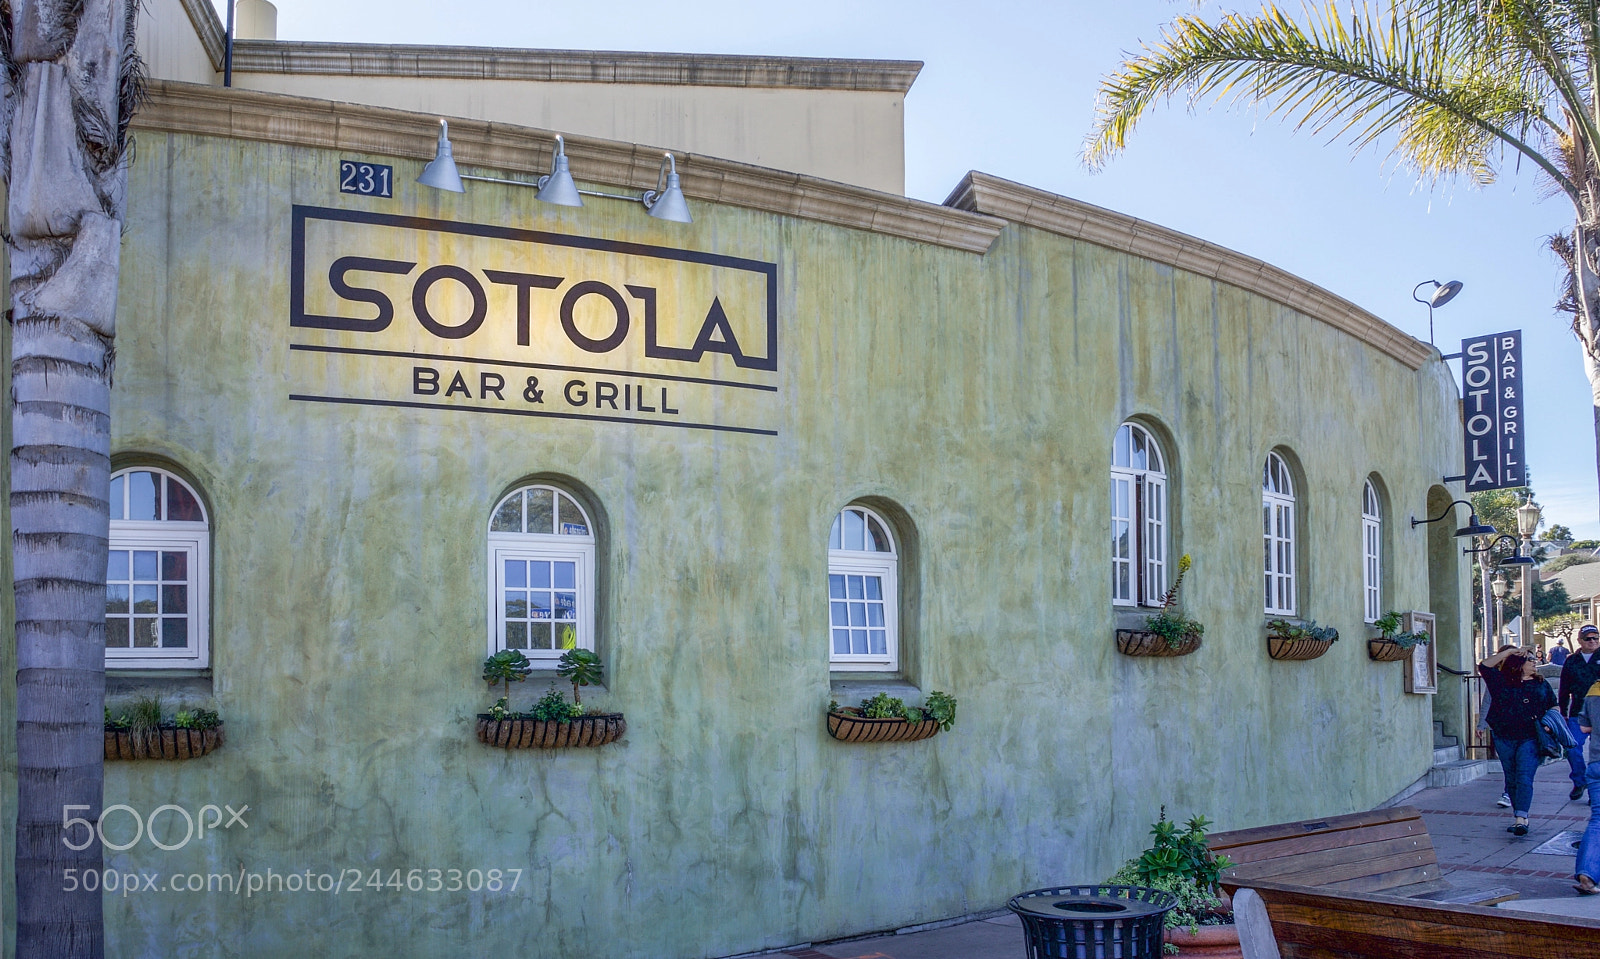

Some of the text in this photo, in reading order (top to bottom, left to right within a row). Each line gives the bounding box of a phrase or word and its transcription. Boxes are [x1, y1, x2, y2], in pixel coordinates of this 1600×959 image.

[342, 163, 390, 196] 231
[329, 256, 744, 368] SOTOLA
[413, 366, 679, 416] BAR & GRILL
[1466, 341, 1493, 486] SOTOLA
[1502, 337, 1517, 482] BAR & GRILL
